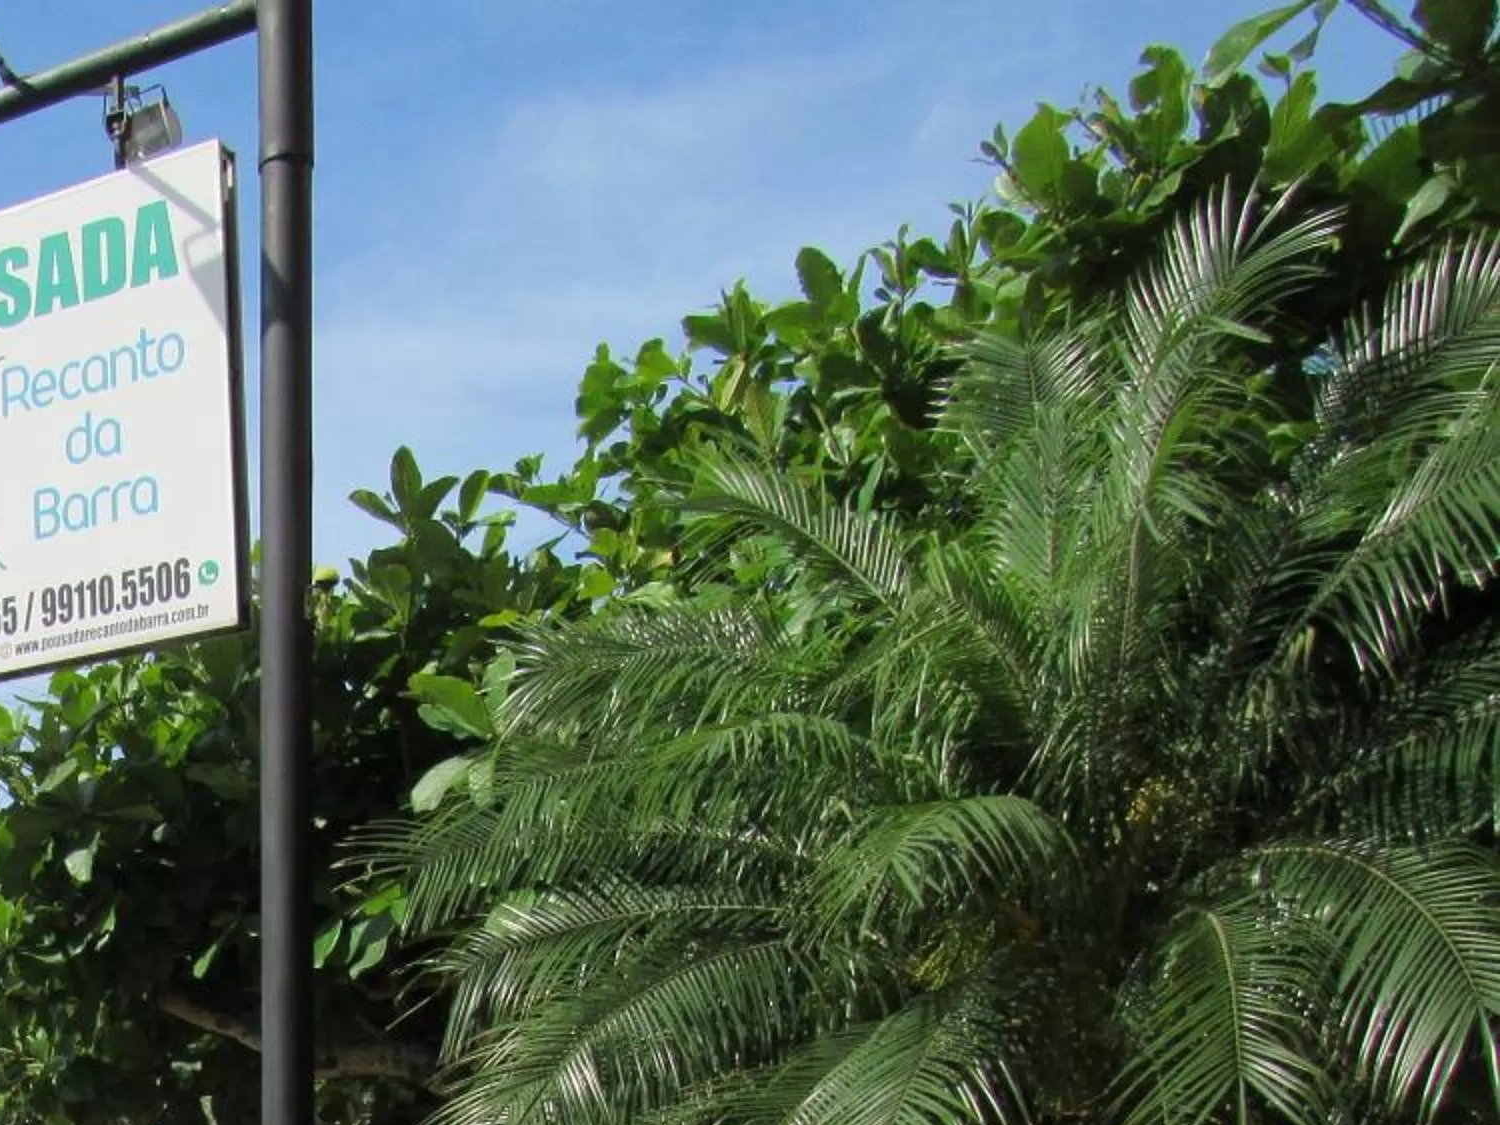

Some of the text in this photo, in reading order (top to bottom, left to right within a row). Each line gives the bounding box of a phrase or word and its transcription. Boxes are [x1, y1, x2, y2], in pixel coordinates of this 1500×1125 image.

[0, 328, 185, 418] Recanto
[65, 410, 122, 464] da
[33, 475, 159, 540] Barra
[41, 557, 191, 628] 99110.5506
